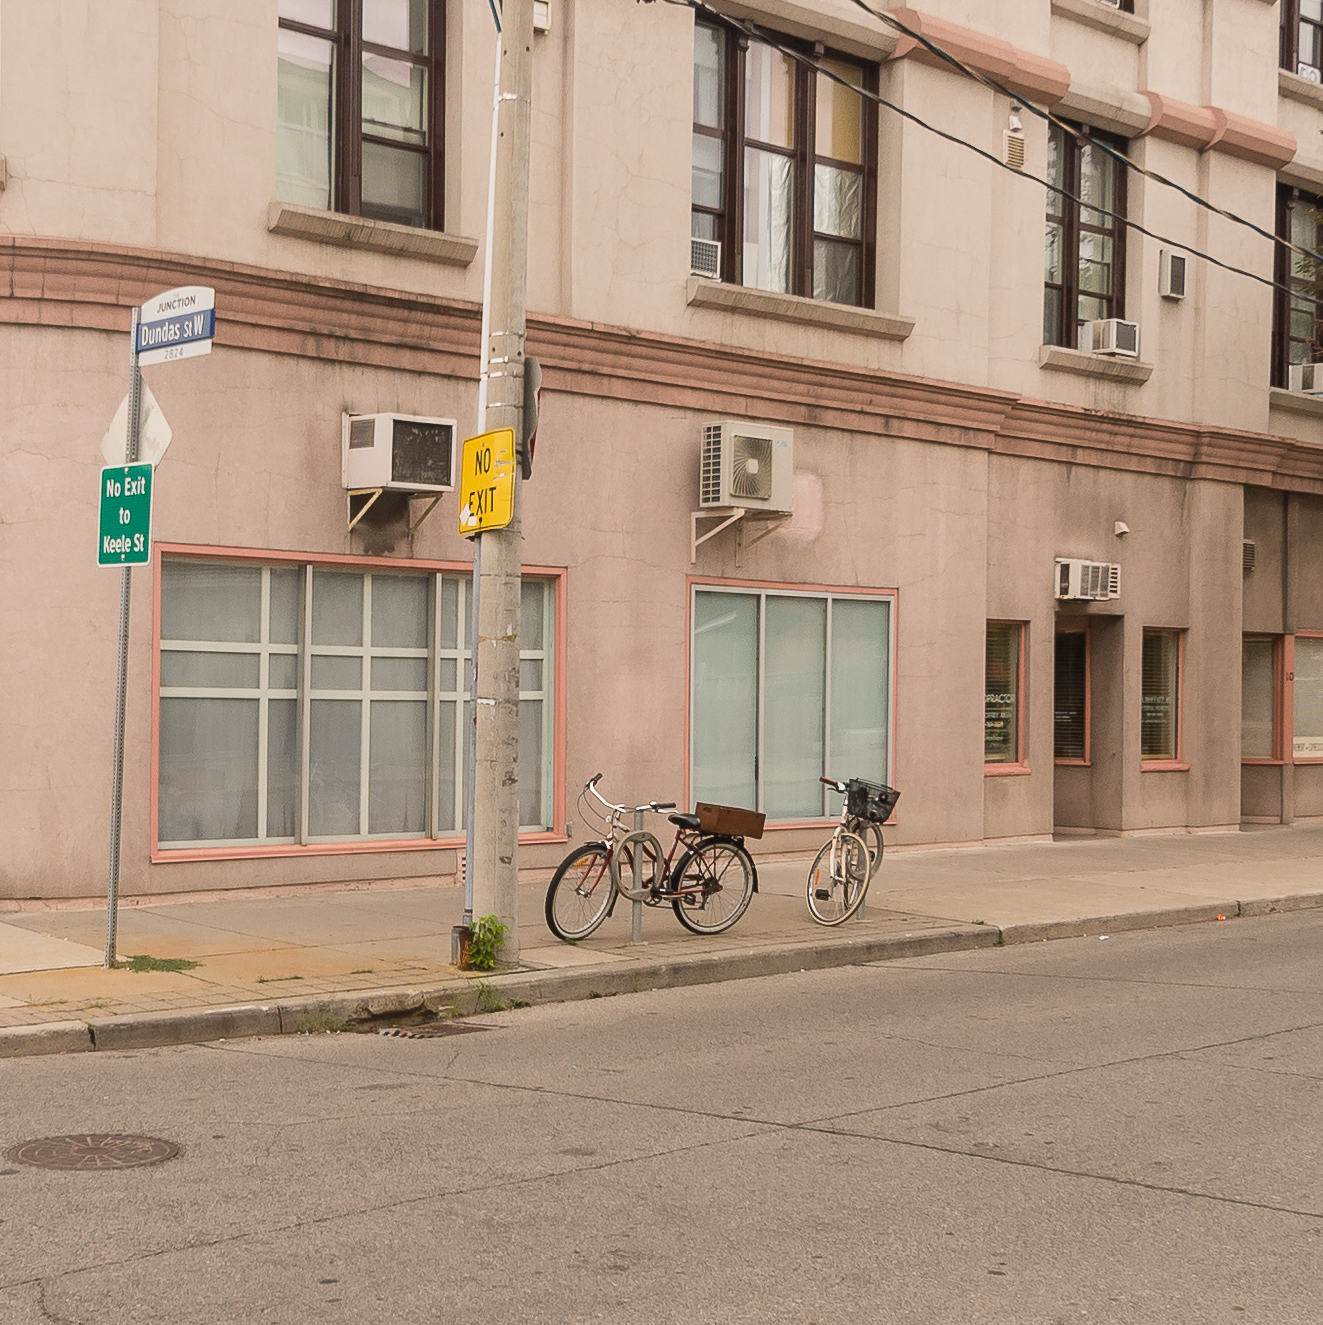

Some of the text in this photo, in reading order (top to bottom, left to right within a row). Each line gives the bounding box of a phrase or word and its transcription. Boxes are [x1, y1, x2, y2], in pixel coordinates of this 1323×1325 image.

[157, 295, 196, 313] JUNCTION
[142, 322, 180, 346] Dundas
[194, 314, 204, 335] W
[164, 348, 184, 359] 2824
[475, 447, 491, 476] NO
[106, 476, 146, 497] No Exit
[469, 486, 497, 517] EXIT
[119, 507, 131, 524] to
[103, 533, 145, 553] Keele St
